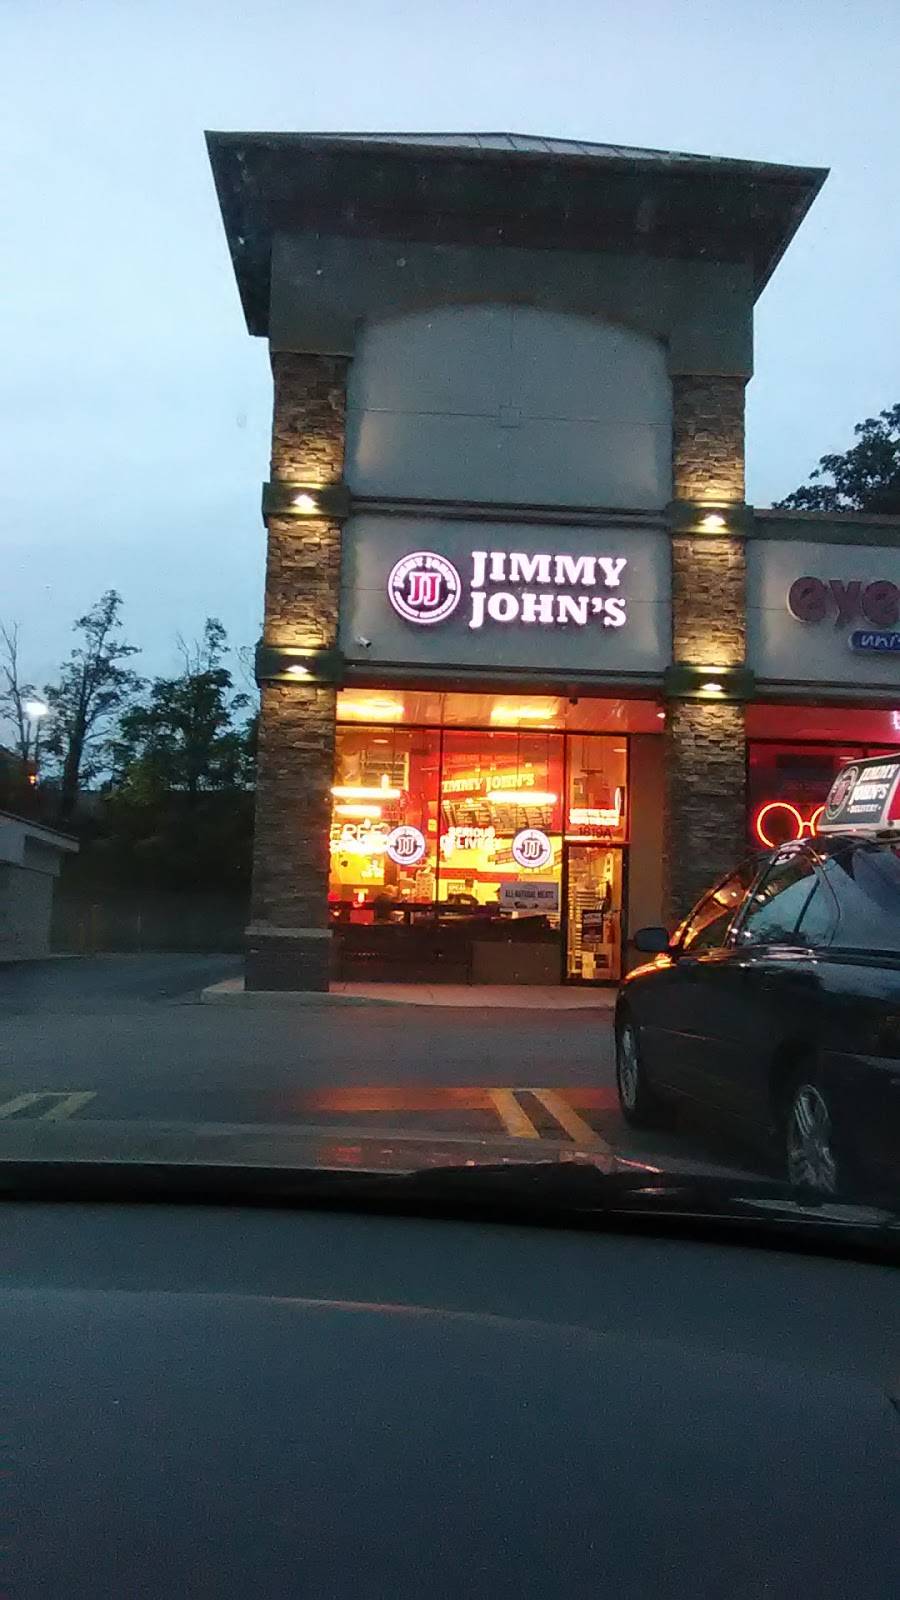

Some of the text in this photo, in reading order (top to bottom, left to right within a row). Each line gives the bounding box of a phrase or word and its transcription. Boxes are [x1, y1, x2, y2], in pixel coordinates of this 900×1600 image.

[407, 571, 441, 605] JJ
[470, 551, 627, 588] JIMMY
[469, 591, 627, 629] JOHN'S
[787, 576, 900, 630] eye
